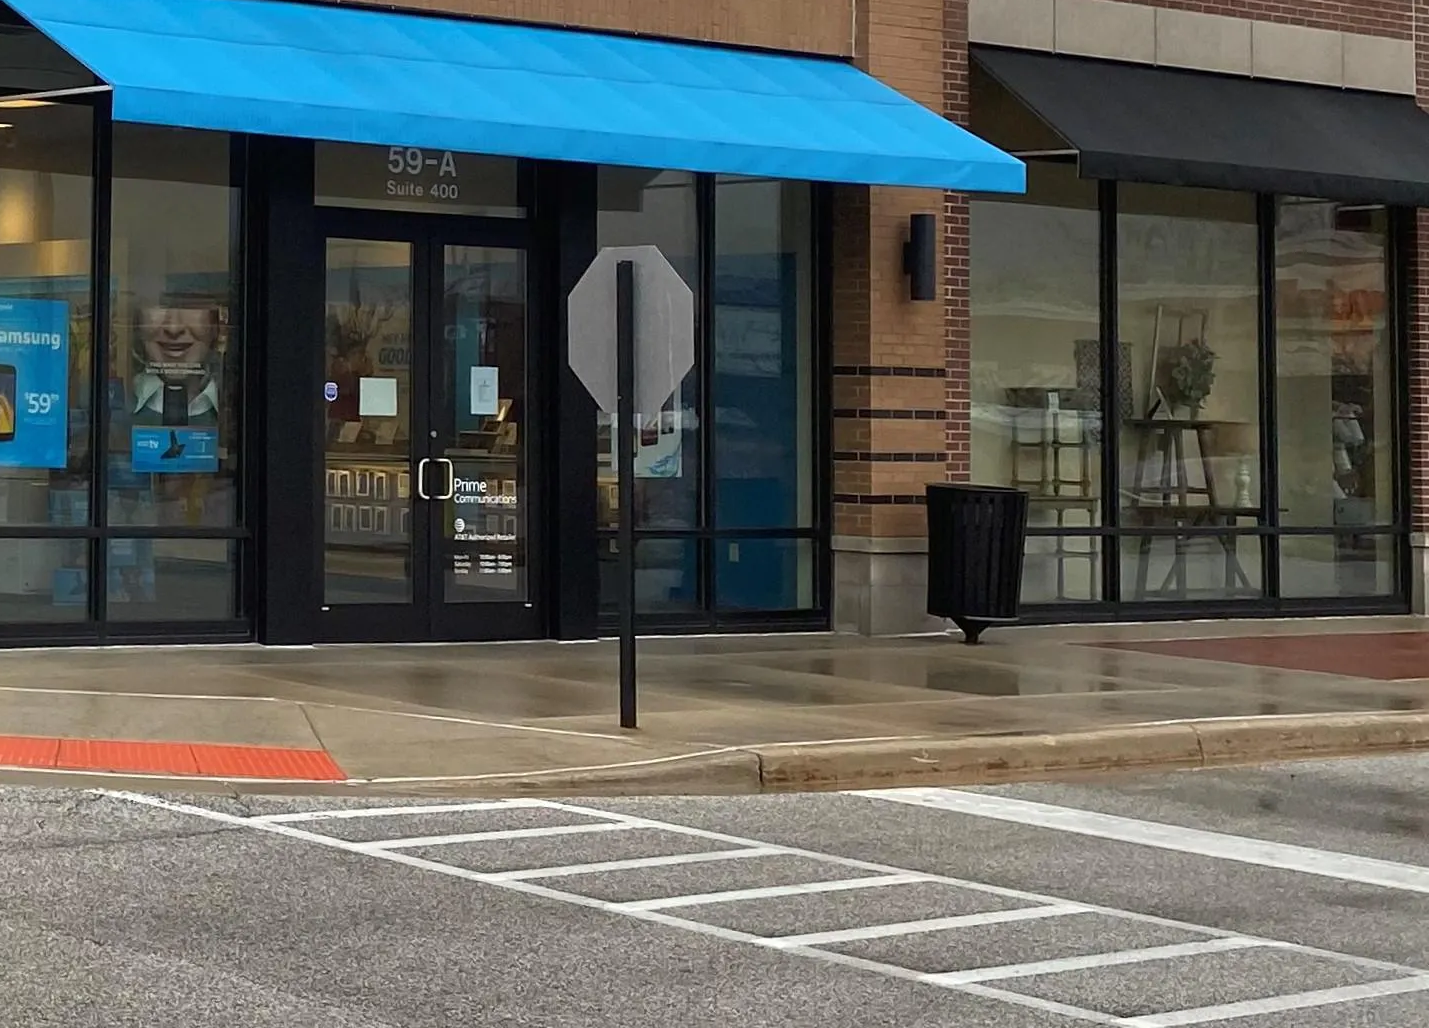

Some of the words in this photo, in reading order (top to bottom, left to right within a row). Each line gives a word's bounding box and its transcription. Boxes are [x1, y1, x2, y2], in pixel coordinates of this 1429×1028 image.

[388, 146, 457, 177] 59-A
[387, 179, 424, 197] Suite
[430, 183, 458, 199] 400
[454, 478, 487, 492] Prime
[454, 493, 517, 504] Communications
